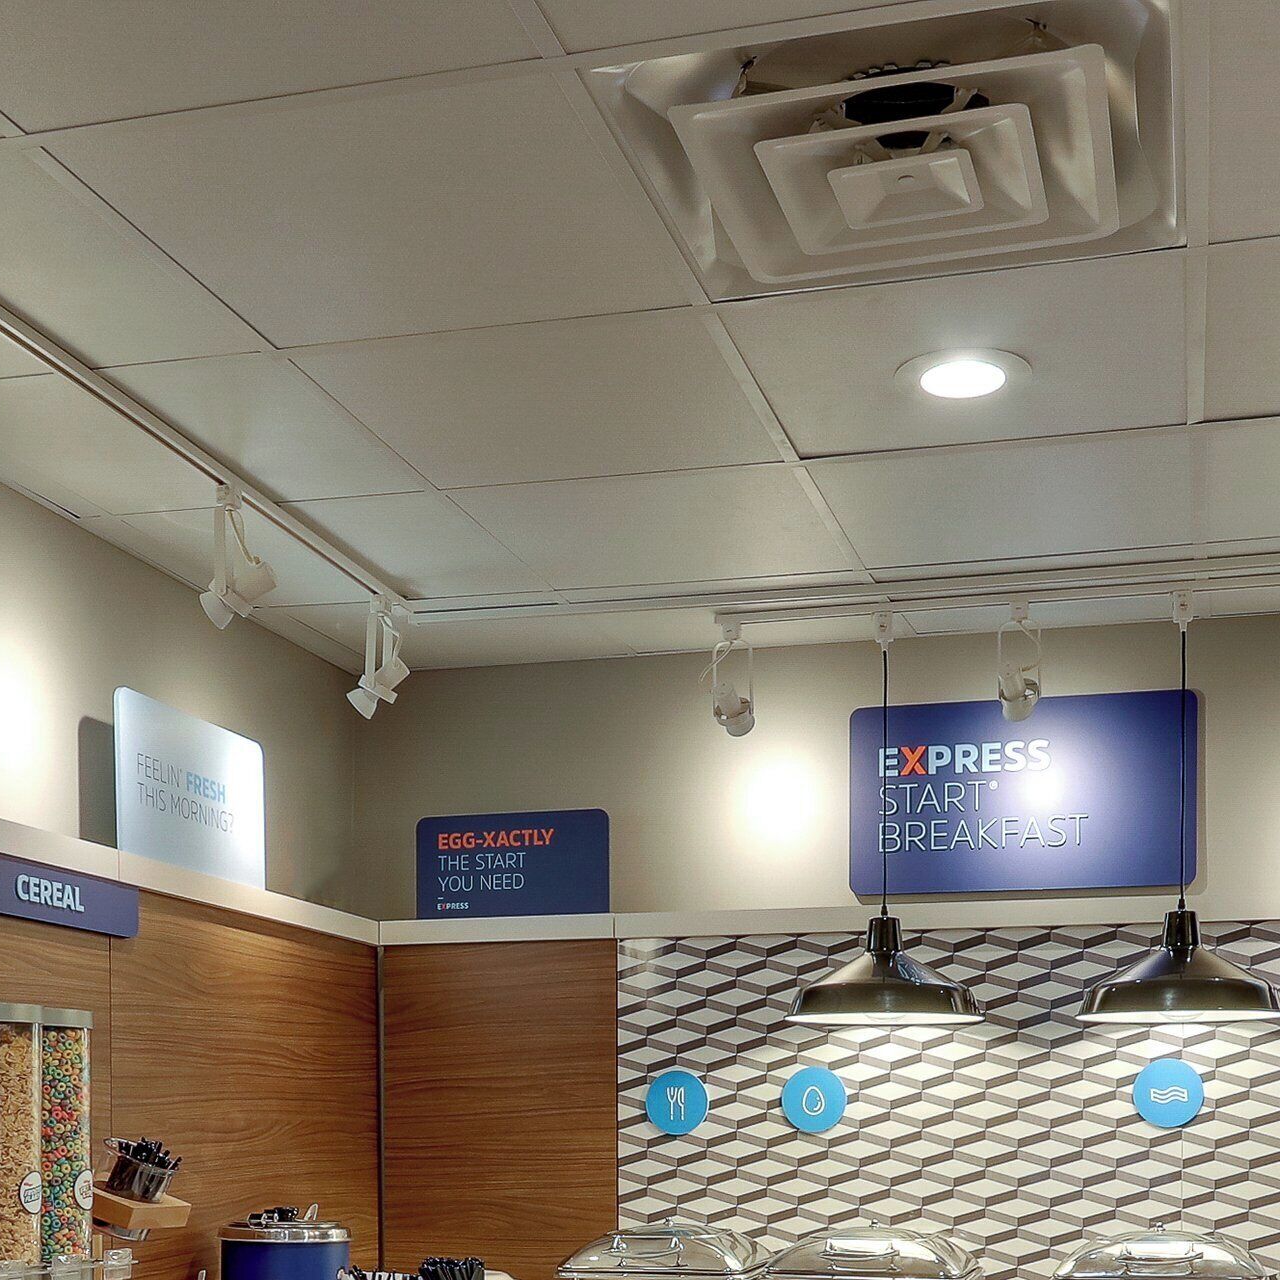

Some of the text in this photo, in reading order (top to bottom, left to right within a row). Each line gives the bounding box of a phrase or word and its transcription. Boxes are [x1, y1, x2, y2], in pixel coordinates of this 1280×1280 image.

[878, 739, 1052, 778] EXPRESS
[186, 771, 227, 805] FRESH
[137, 781, 235, 834] THIS MORNING?
[437, 828, 555, 850] EGG-XACTLY
[878, 812, 1089, 854] BREAKFAST
[438, 851, 527, 872] THE START
[15, 873, 86, 913] CEREAL
[437, 873, 525, 893] YOU NEED
[437, 902, 470, 911] EXPRESS
